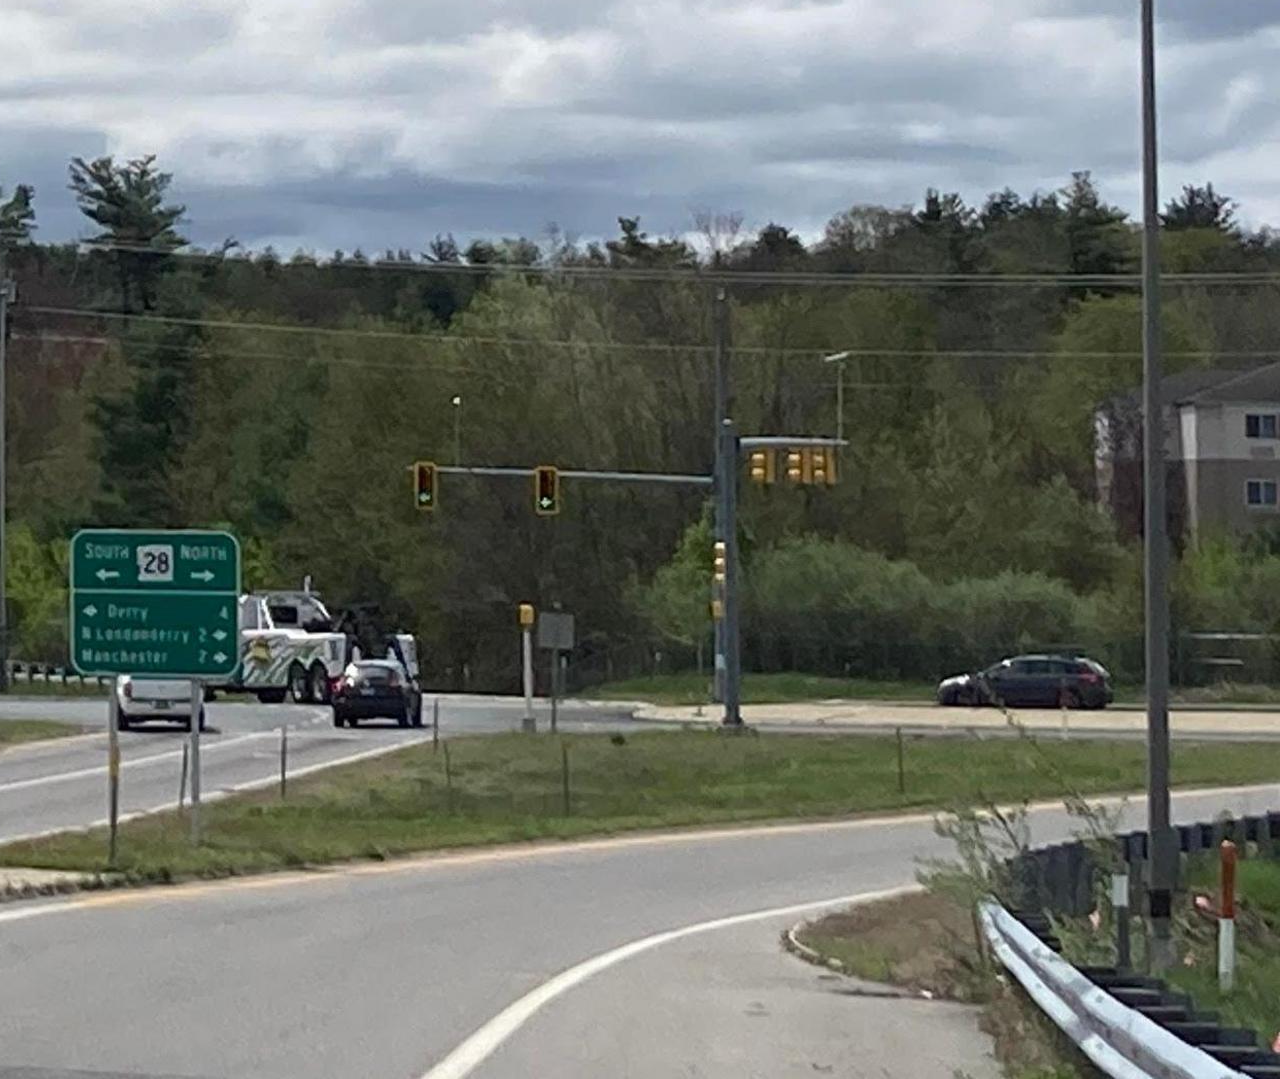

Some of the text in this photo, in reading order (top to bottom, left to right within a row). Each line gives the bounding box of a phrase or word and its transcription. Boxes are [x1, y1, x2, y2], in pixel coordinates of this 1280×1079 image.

[143, 551, 170, 575] 28
[107, 603, 149, 622] Derry
[95, 627, 189, 645] Londonderry
[81, 648, 168, 664] Manchester
